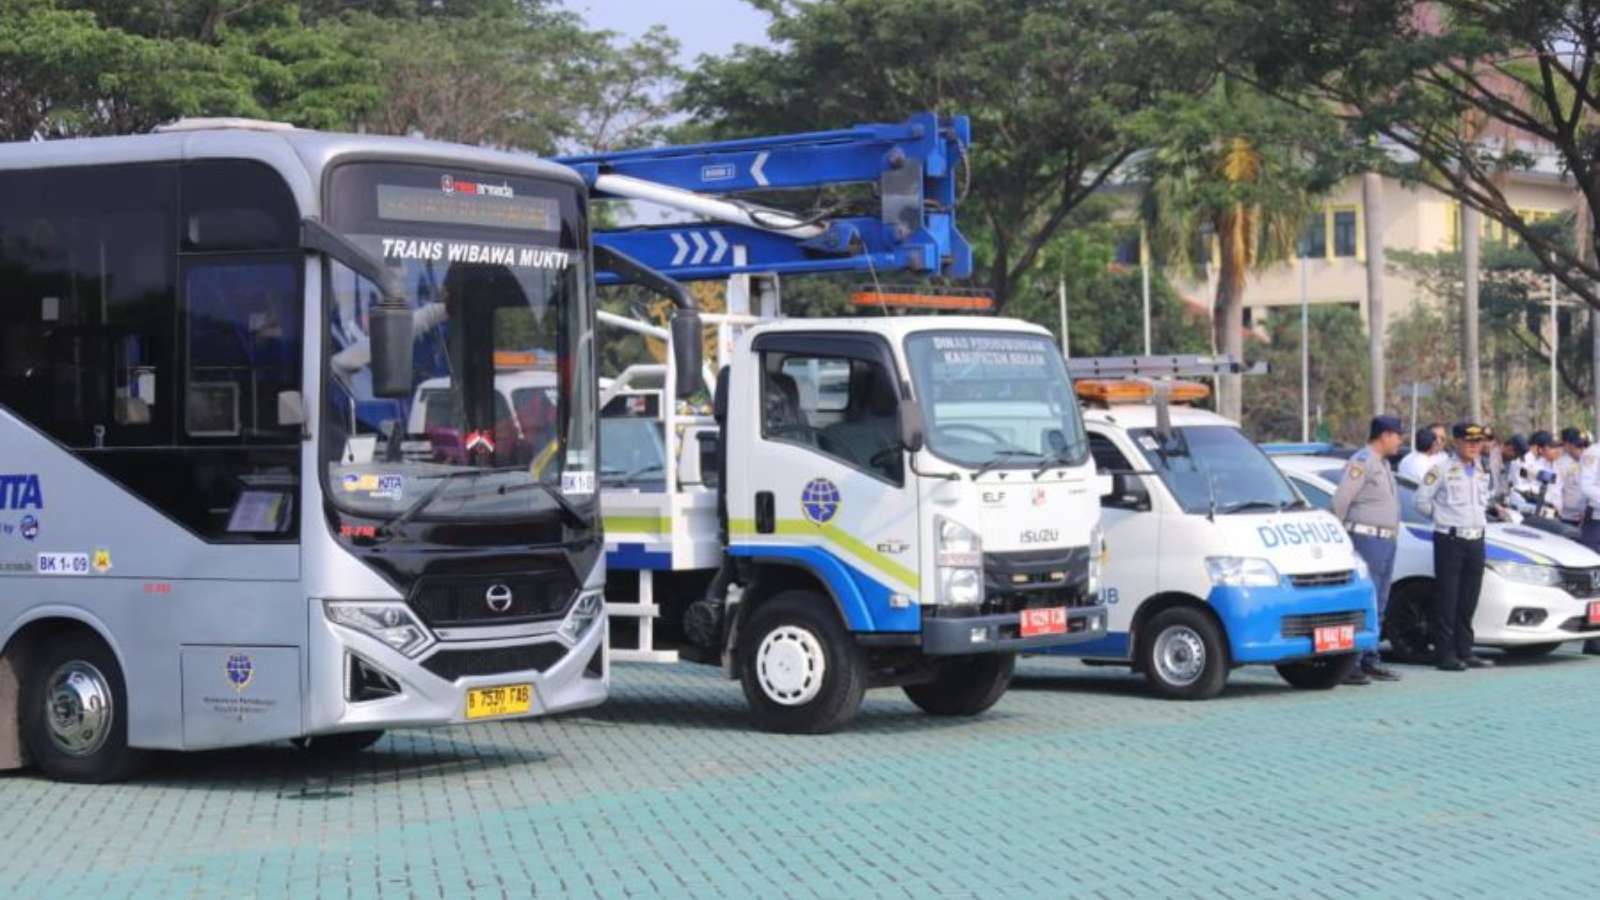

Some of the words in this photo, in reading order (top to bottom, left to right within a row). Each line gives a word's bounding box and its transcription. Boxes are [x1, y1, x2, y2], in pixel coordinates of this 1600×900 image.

[382, 238, 442, 260] TRANS
[447, 243, 515, 266] WIBAWA
[519, 248, 569, 270] MUKTI
[982, 491, 1006, 503] ELF
[1020, 528, 1059, 543] ISUZU
[1256, 521, 1344, 548] DISHUB
[877, 543, 911, 554] ELF
[40, 556, 56, 570] BK
